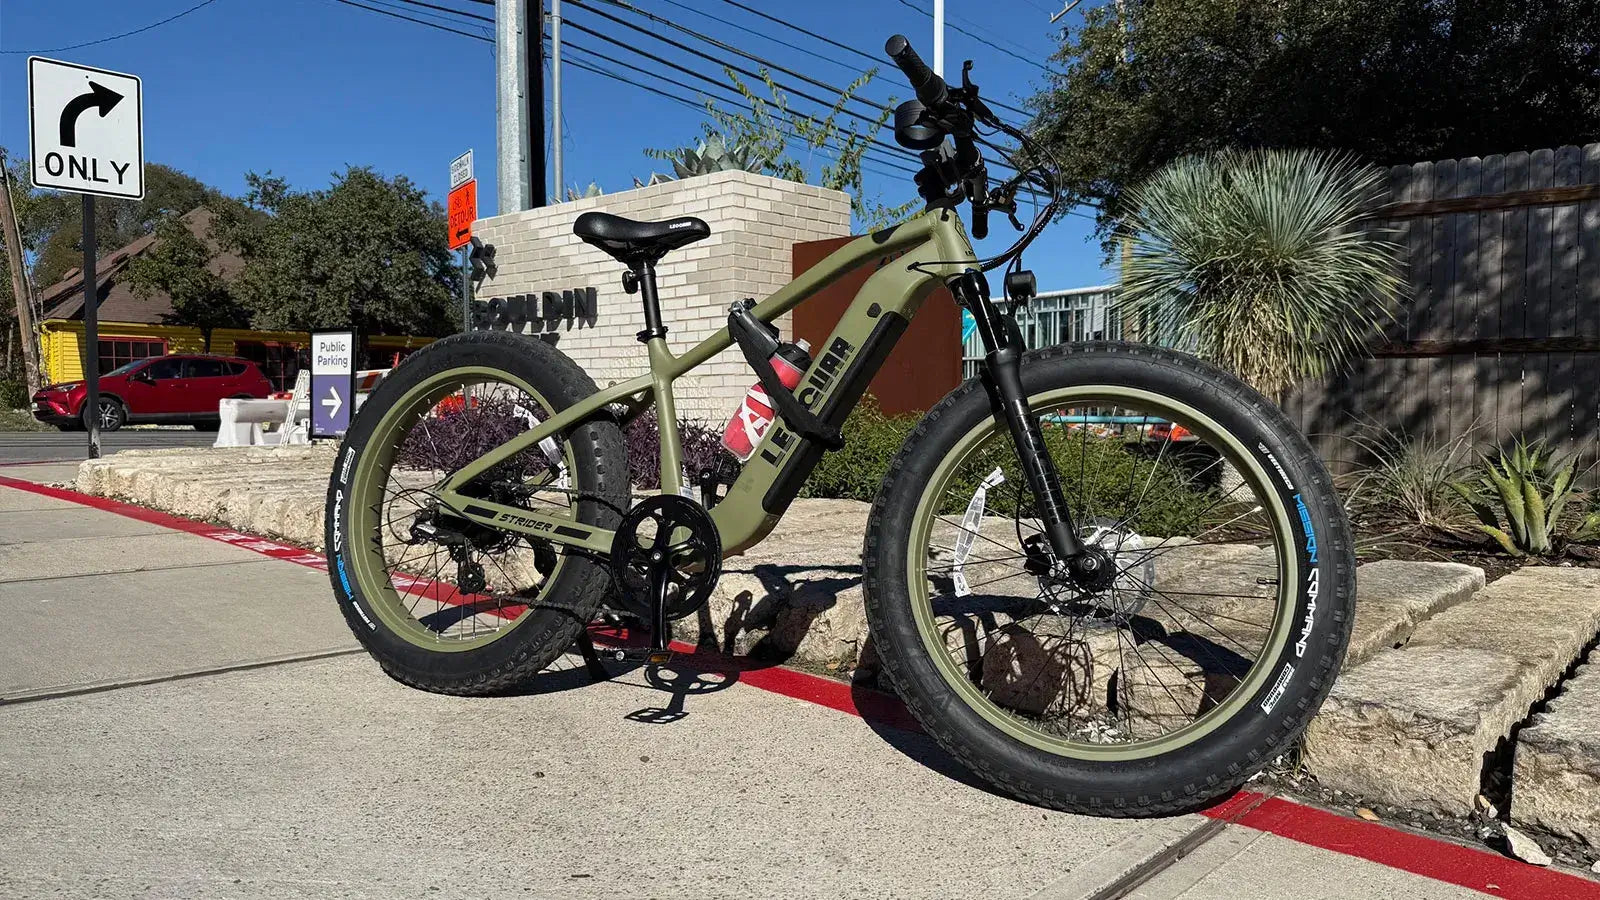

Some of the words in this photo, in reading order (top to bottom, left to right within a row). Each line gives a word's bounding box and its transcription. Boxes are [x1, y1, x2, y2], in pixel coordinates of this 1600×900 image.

[44, 151, 131, 185] ONLY
[450, 206, 475, 229] DETOUR
[320, 341, 346, 352] Public
[317, 355, 348, 369] Parking
[498, 513, 553, 532] STRIDER
[1292, 493, 1319, 563] MISSION
[1295, 568, 1319, 658] COMMAND
